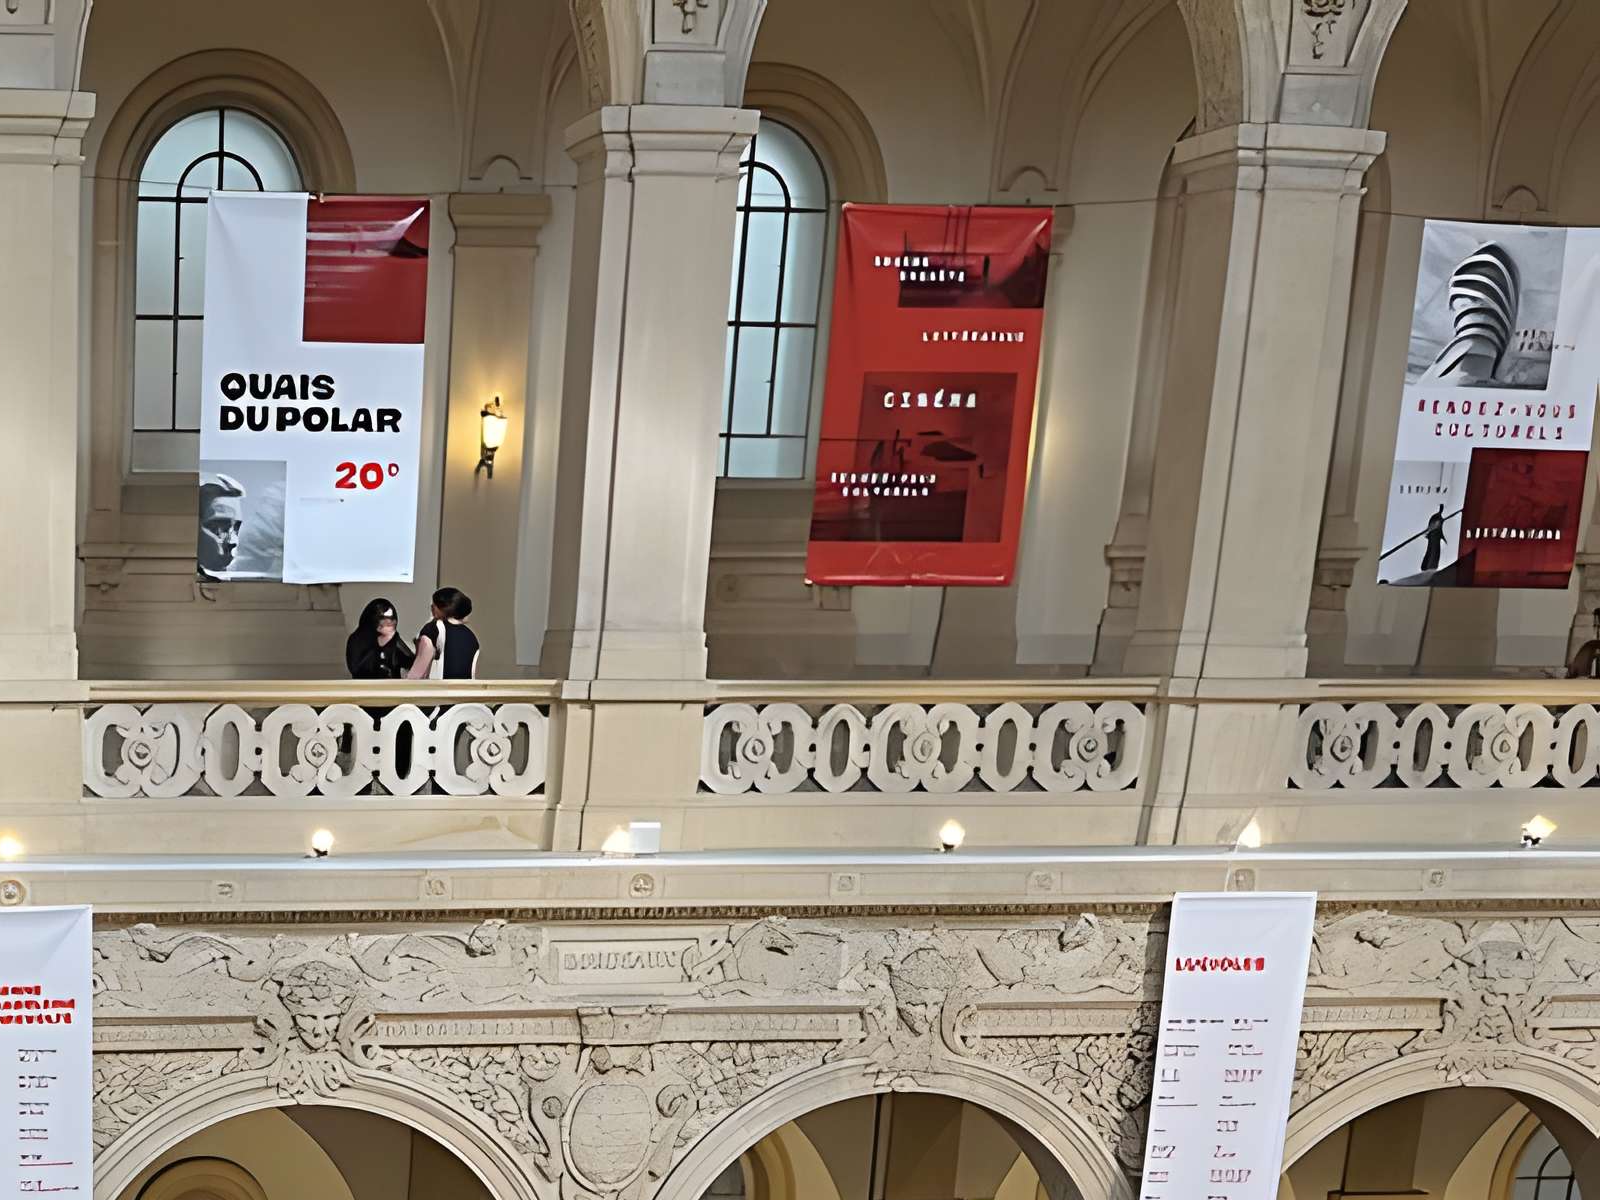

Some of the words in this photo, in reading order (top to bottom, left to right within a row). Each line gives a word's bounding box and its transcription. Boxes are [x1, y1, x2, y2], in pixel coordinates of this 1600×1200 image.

[220, 372, 335, 401] QUAIS
[220, 405, 269, 432] DU
[275, 406, 402, 433] POLAR
